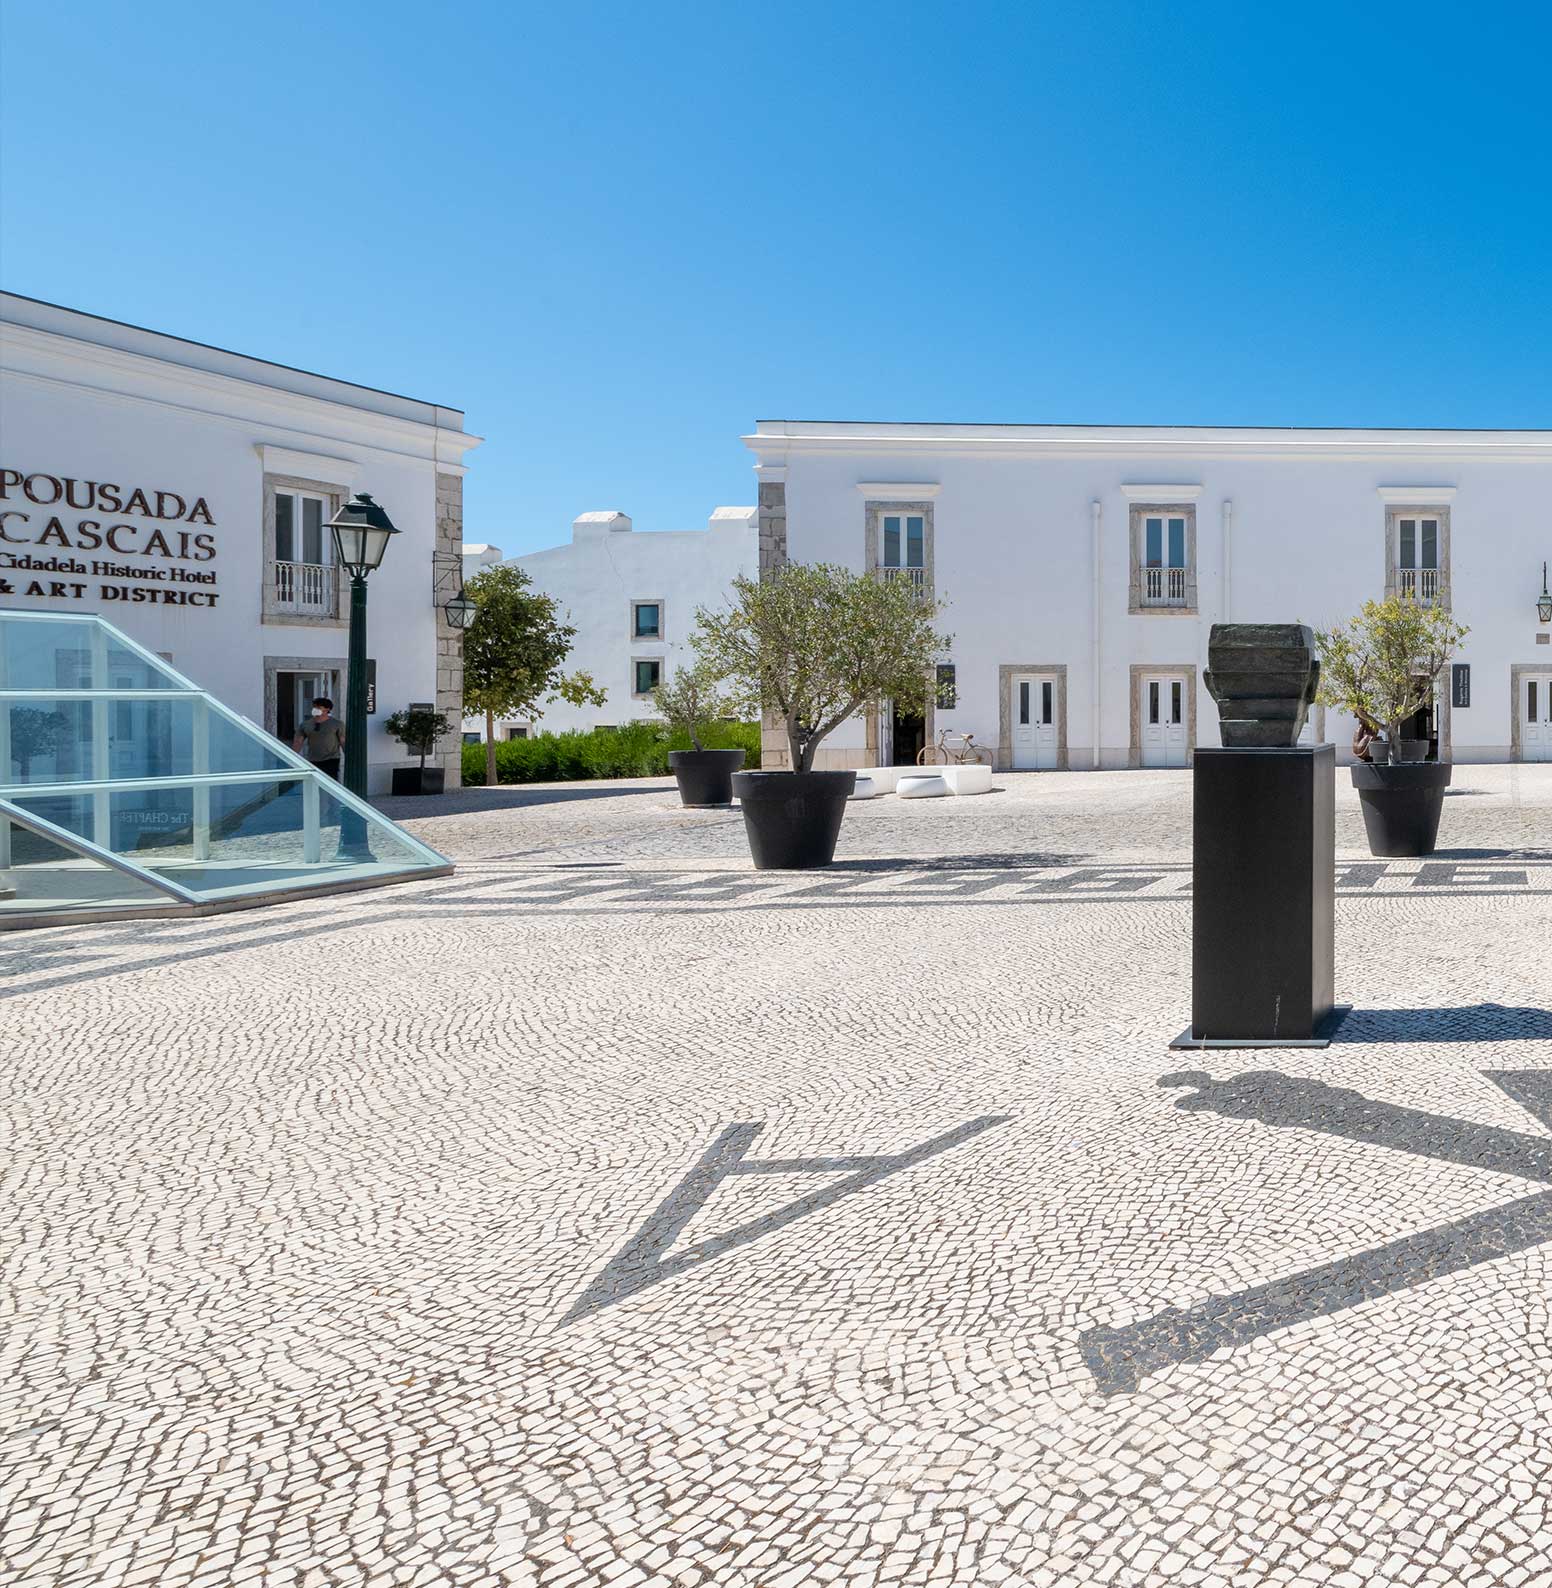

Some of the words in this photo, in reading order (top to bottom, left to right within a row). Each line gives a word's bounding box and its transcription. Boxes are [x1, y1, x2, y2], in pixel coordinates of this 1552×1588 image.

[0, 468, 217, 526] POUSADA
[0, 511, 217, 562] CASCAIS
[0, 552, 87, 575] Cidadela
[91, 560, 167, 581] Historic
[169, 567, 217, 585] Hotel
[24, 580, 87, 599] ART
[100, 584, 219, 608] DISTRICT
